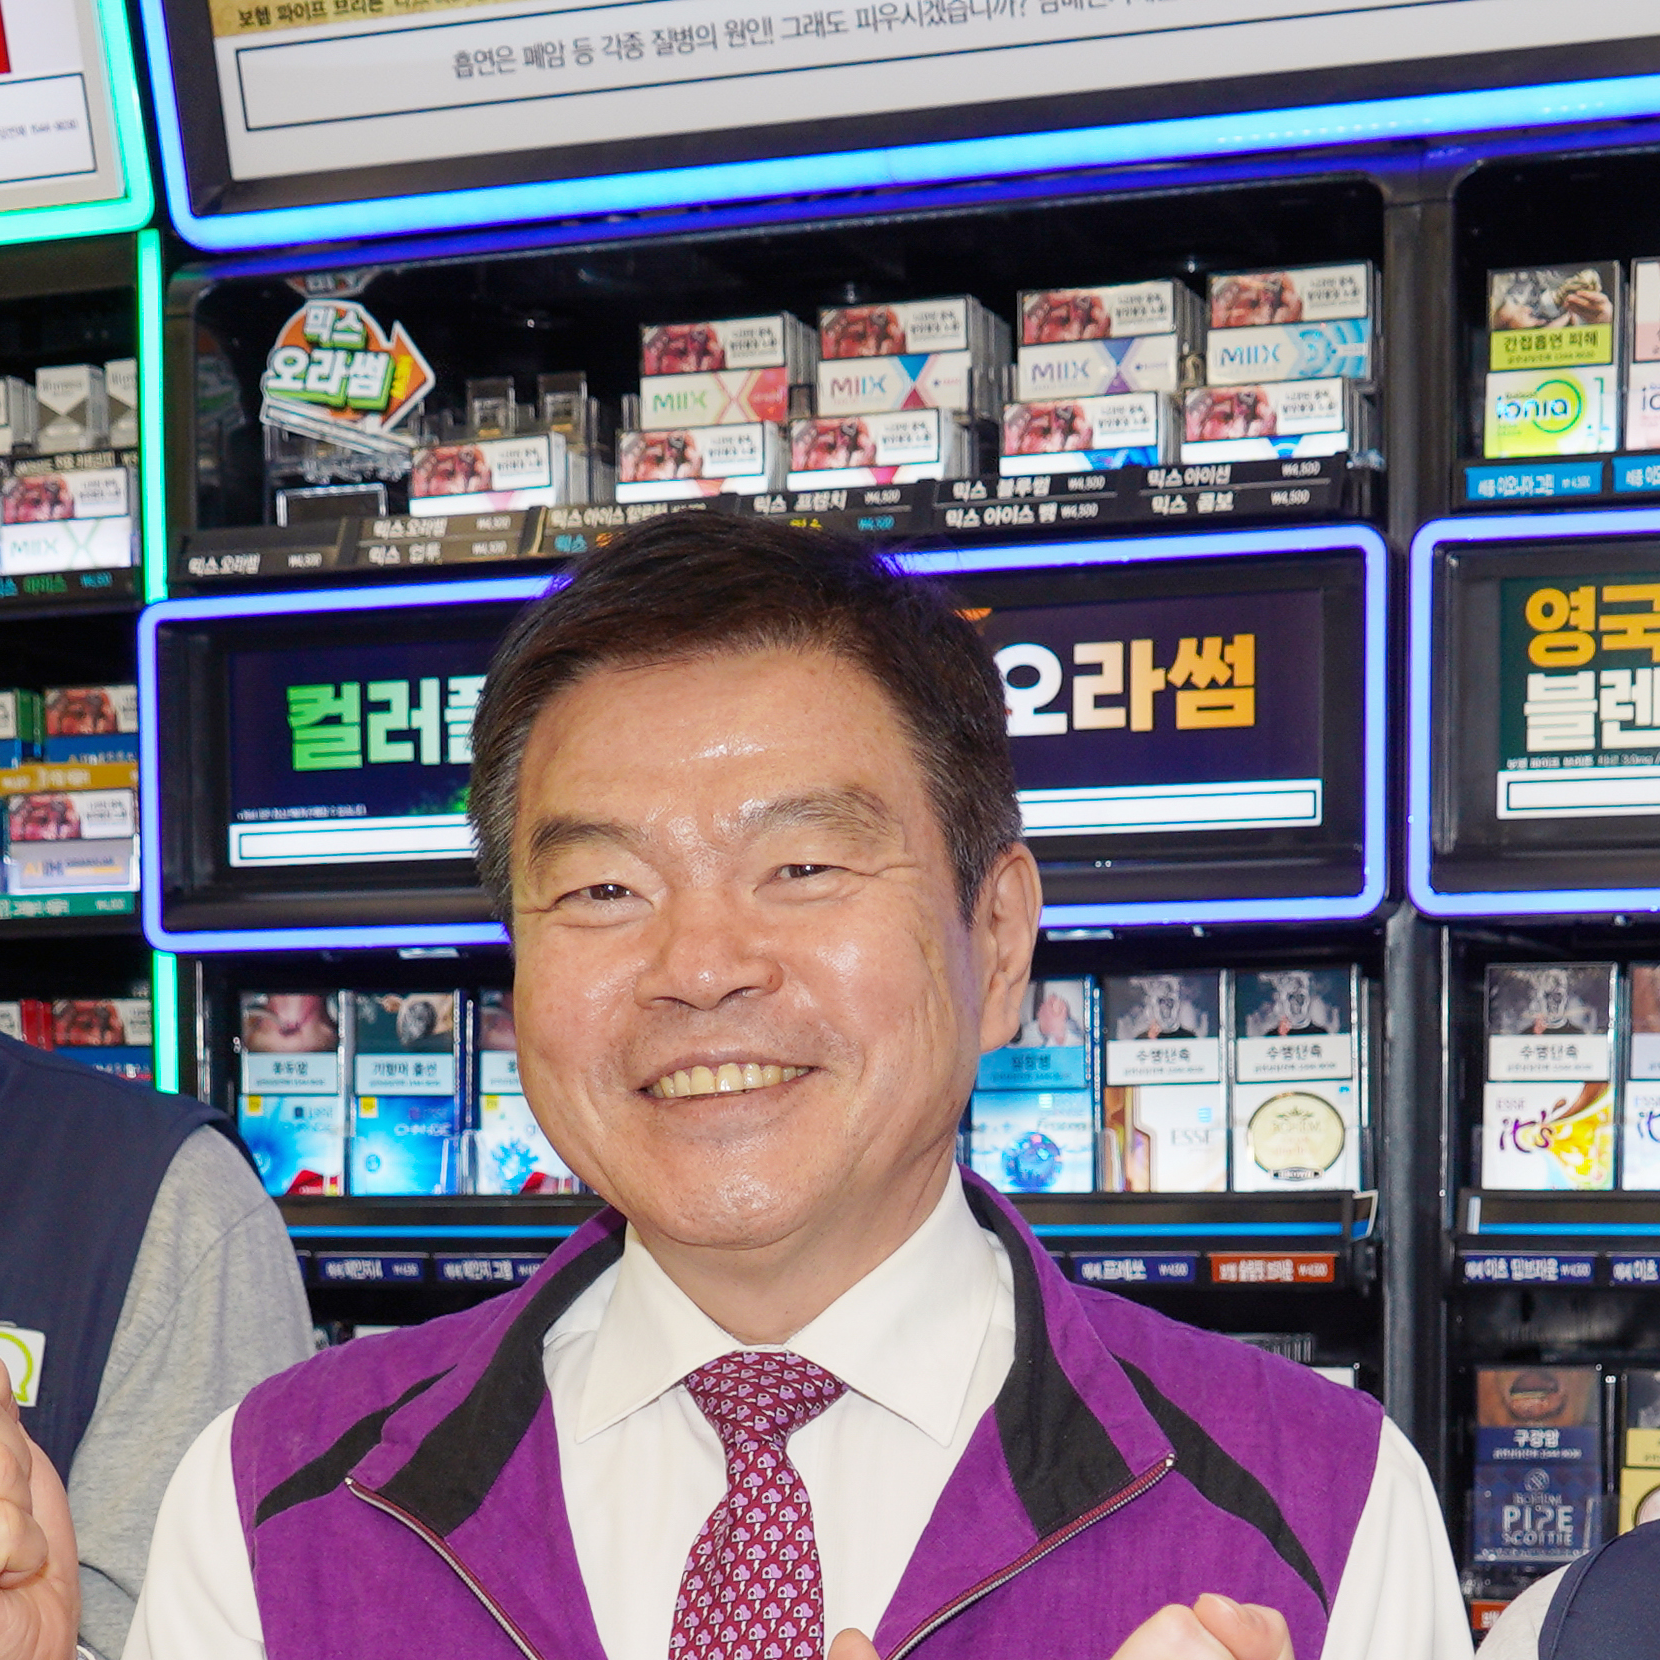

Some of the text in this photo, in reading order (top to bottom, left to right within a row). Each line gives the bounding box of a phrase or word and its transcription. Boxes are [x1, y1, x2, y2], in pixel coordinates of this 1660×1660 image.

[452, 48, 518, 80] 흡연은
[522, 40, 567, 71] 폐암
[572, 35, 595, 66] 등
[601, 31, 645, 63] 각종
[651, 23, 718, 56] 질병의
[724, 15, 775, 49] 원인!
[780, 9, 849, 41] 그래도
[1217, 342, 1282, 366] MIIX
[1504, 332, 1567, 353] 간접흡연
[269, 346, 393, 401] 오라썸
[1029, 357, 1091, 385] MIIX
[829, 373, 888, 398] MIIX
[1496, 396, 1570, 420] ionia
[993, 632, 1256, 739] 오라썸
[1498, 1109, 1555, 1154] it's
